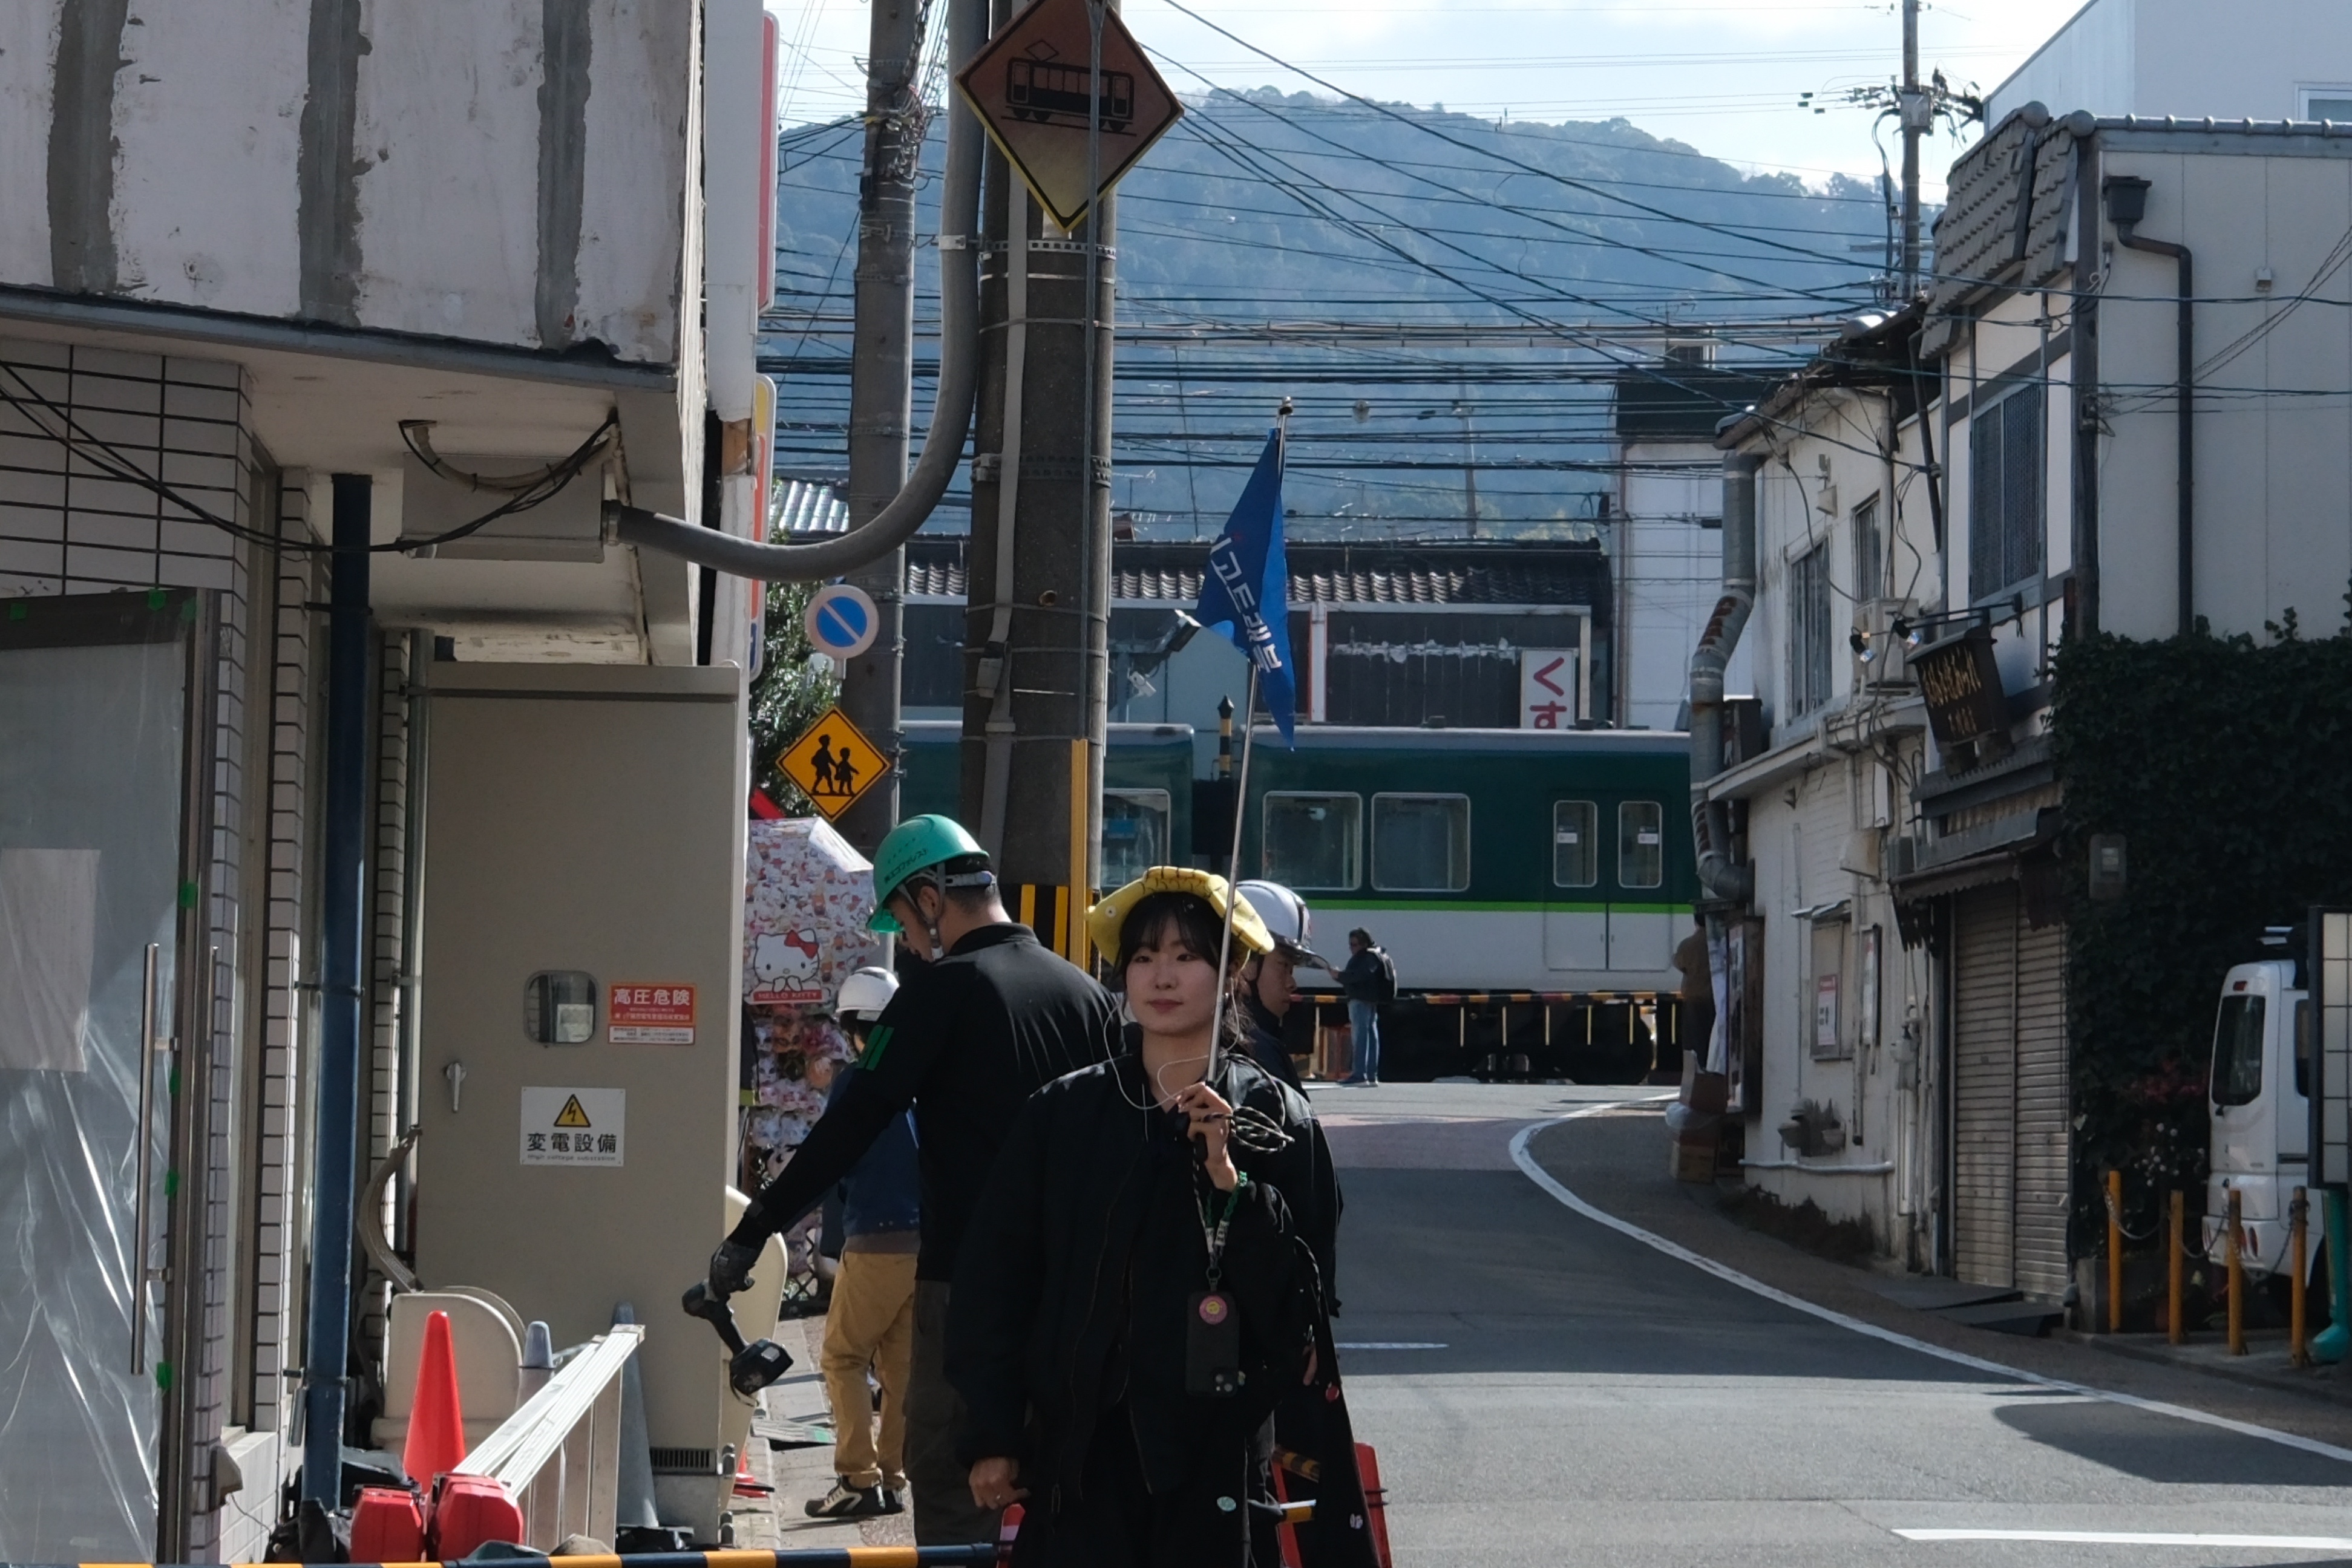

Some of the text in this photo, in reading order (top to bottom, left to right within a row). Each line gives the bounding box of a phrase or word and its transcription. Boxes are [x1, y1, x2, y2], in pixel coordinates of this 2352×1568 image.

[614, 988, 690, 1005] 高圧危険
[527, 1132, 617, 1154] 変電設備
